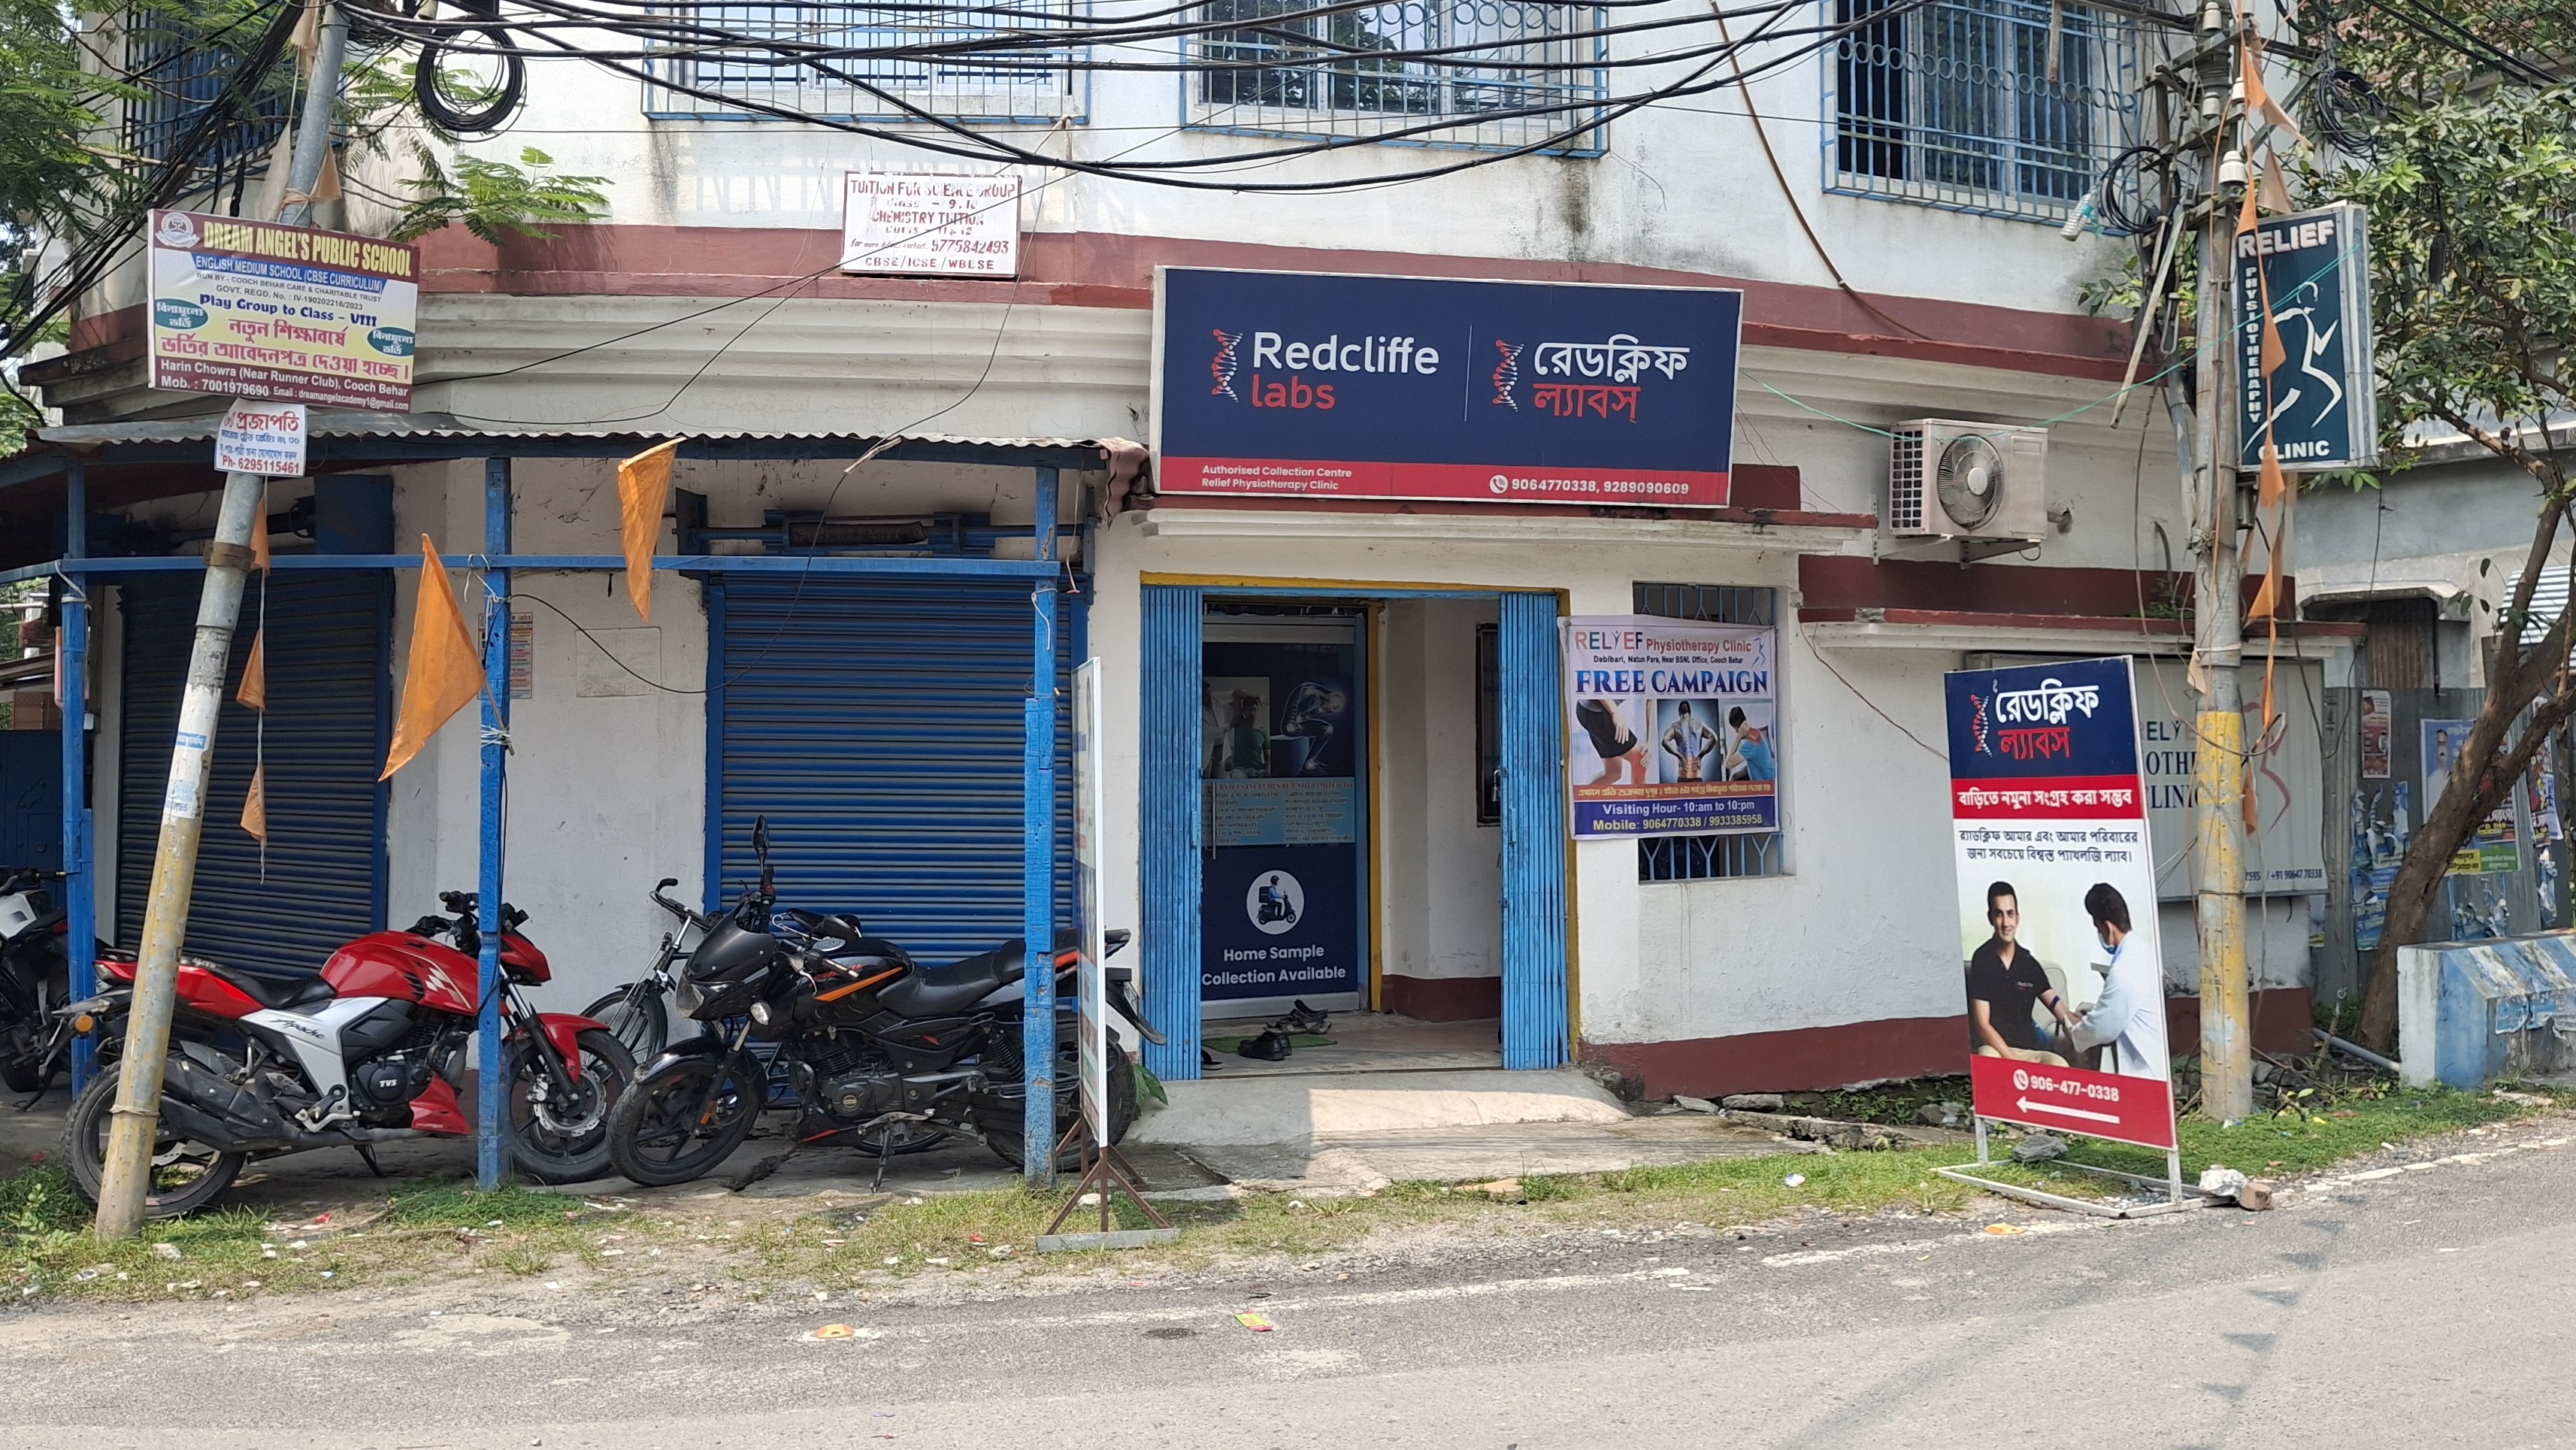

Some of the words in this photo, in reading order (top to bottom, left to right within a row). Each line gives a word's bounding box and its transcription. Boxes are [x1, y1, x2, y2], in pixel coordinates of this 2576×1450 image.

[871, 210, 934, 224] CHEMISTRY
[204, 221, 253, 253] DREAM
[256, 227, 310, 261] ANGEL'S
[312, 235, 360, 268] PUBLIC
[362, 243, 412, 277] SCHOOL
[2238, 219, 2335, 259] RELIEF
[195, 256, 233, 271] ENGLISH
[235, 262, 268, 276] MEDIUM
[269, 265, 302, 280] SCHOOL
[304, 269, 328, 285] (CBSE
[330, 273, 383, 295] CURRICULUM)
[216, 285, 242, 295] GOVT.
[244, 286, 271, 298] REGD.
[232, 276, 258, 286] COOCH
[260, 279, 285, 289] BEHAR
[287, 283, 307, 292] CARE
[315, 287, 358, 299] CHARITABLE
[359, 293, 382, 303] TRUST
[200, 294, 232, 309] Play
[237, 298, 278, 315] Group
[283, 304, 296, 316] to
[301, 306, 334, 321] Class
[350, 313, 377, 327] VIII
[229, 319, 270, 344] নতুন
[273, 319, 349, 347] শিক্ষাবর্ষে
[2245, 266, 2262, 423] PHYSIOTHERAPY
[160, 332, 209, 357] ভর্তির
[213, 342, 307, 368] আবেদনপত্র
[1253, 331, 1439, 374] Redcliffe
[1534, 334, 1691, 383] রেডক্লিফ
[161, 359, 192, 372] Harin
[194, 362, 237, 377] Chowra
[239, 366, 268, 380] (Near
[271, 370, 307, 385] Runner
[311, 374, 341, 390] Club),
[344, 378, 376, 393] Cooch
[379, 383, 408, 397] Behar
[161, 375, 191, 389] Mob.
[201, 378, 269, 397] 7001979690
[274, 386, 293, 397] Email
[298, 388, 409, 410] dreamangelacademy1@gmail.com
[1252, 374, 1336, 410] labs
[237, 410, 300, 431] প্রজাপতি
[238, 457, 299, 474] 6295115461
[1203, 465, 1260, 475] Authorised
[1262, 466, 1315, 477] Collection
[1316, 468, 1352, 478] Centre
[1202, 478, 1230, 487] Relief
[1233, 479, 1308, 492] Physiotherapy
[1309, 480, 1339, 490] Clinic
[1512, 478, 1600, 494] 9064770338,
[1603, 480, 1689, 495] 9289090609
[1646, 638, 1719, 655] Physiotherapy
[1723, 639, 1751, 652] Clinic
[1594, 655, 1625, 664] Debibari,
[1710, 656, 1727, 664] Cooch
[1729, 656, 1743, 664] Behar
[1576, 670, 1646, 694] FREE
[1651, 670, 1768, 694] CAMPAIGN
[1995, 678, 2099, 725] রেডক্লিফ
[1603, 804, 1650, 816] Visiting
[1652, 803, 1681, 814] Hour-
[1684, 801, 1712, 813] 10:am
[1715, 801, 1724, 811] to
[1727, 800, 1754, 812] 10:pm
[1957, 787, 1999, 810] বাড়িতে
[2000, 791, 2032, 810] নমুনা
[2033, 790, 2069, 808] সংগ্রহ
[2071, 789, 2097, 806] করা
[2099, 789, 2133, 808] সম্ভব
[1594, 819, 1639, 831] Mobile:
[1642, 816, 1701, 830] 9064770338
[1709, 814, 1763, 827] 9933385958
[2002, 831, 2032, 842] আমার
[2035, 831, 2053, 842] এবং
[2056, 831, 2087, 843] আমার
[2090, 828, 2138, 843] পরিবারের
[1966, 848, 1987, 860] জন্য
[1224, 949, 1267, 962] Home
[1270, 944, 1324, 962] Sample
[1202, 970, 1276, 985] Collection
[1279, 966, 1346, 982] Available
[379, 1079, 398, 1088] TVS
[2030, 1075, 2120, 1103] 906-477-0338
